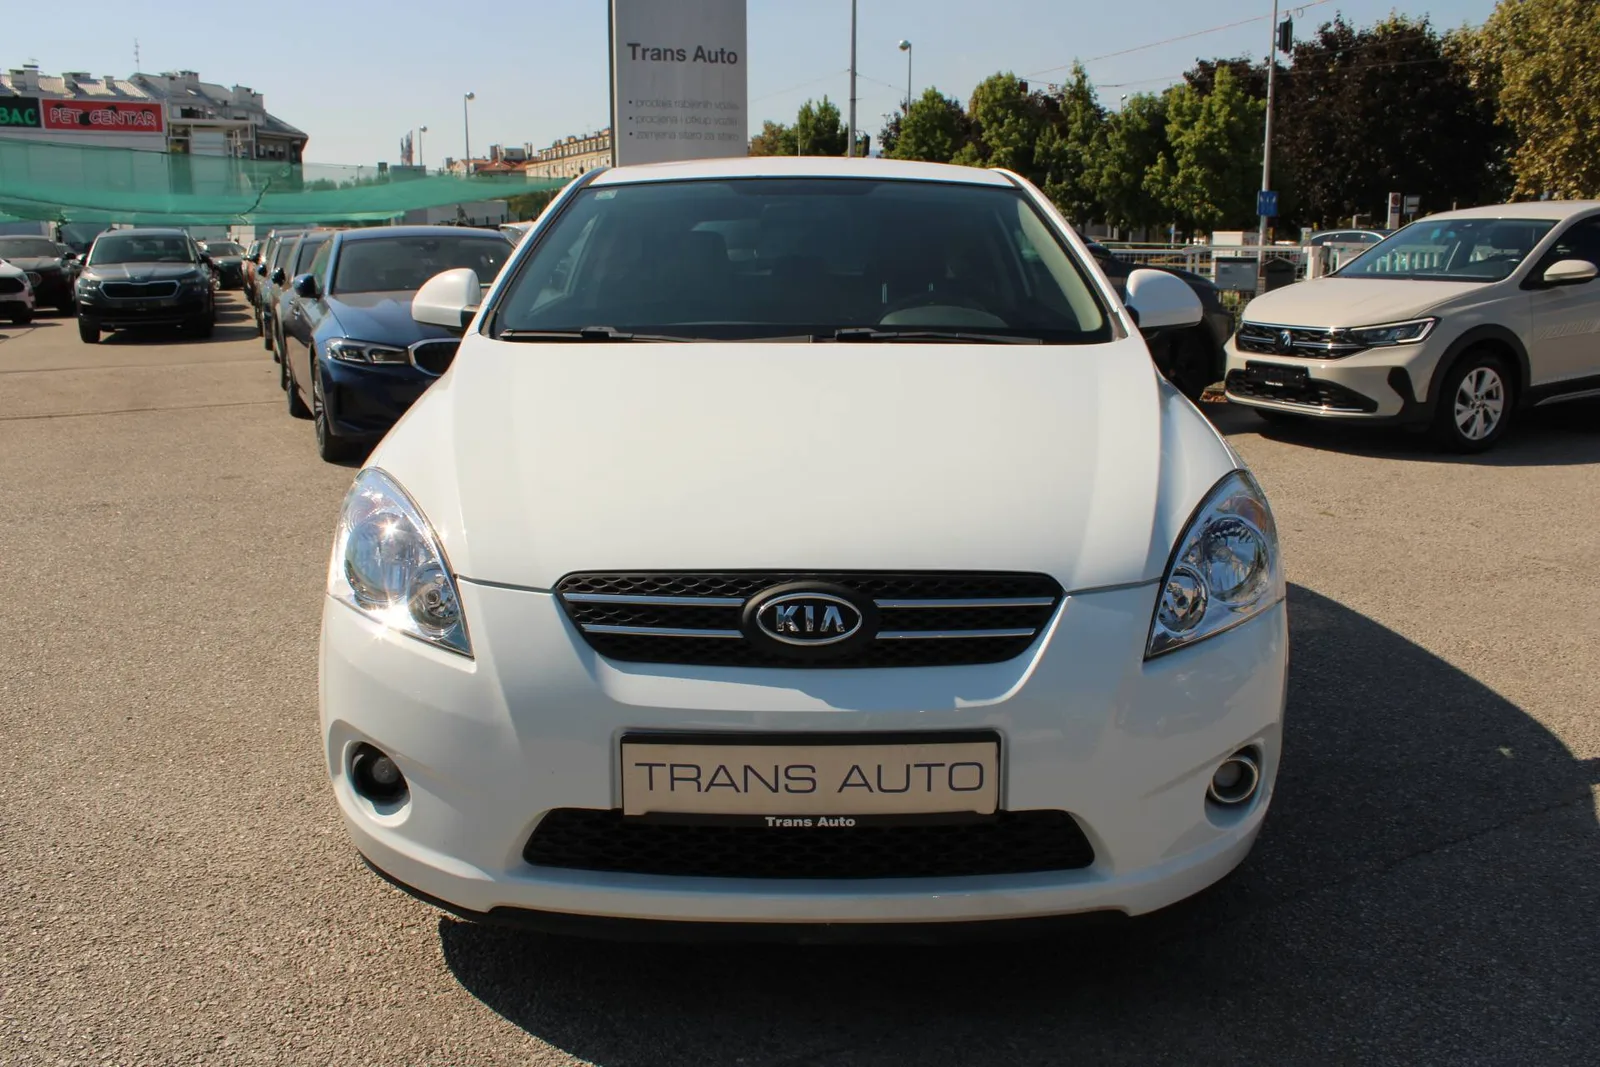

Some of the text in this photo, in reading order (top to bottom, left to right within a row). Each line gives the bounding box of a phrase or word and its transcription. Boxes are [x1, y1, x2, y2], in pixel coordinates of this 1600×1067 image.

[626, 42, 739, 65] Trans Auto
[50, 107, 157, 127] PET CENTAR
[775, 605, 846, 632] KIA
[634, 761, 985, 794] TRANS AUTO
[765, 816, 857, 828] Trans Auto
